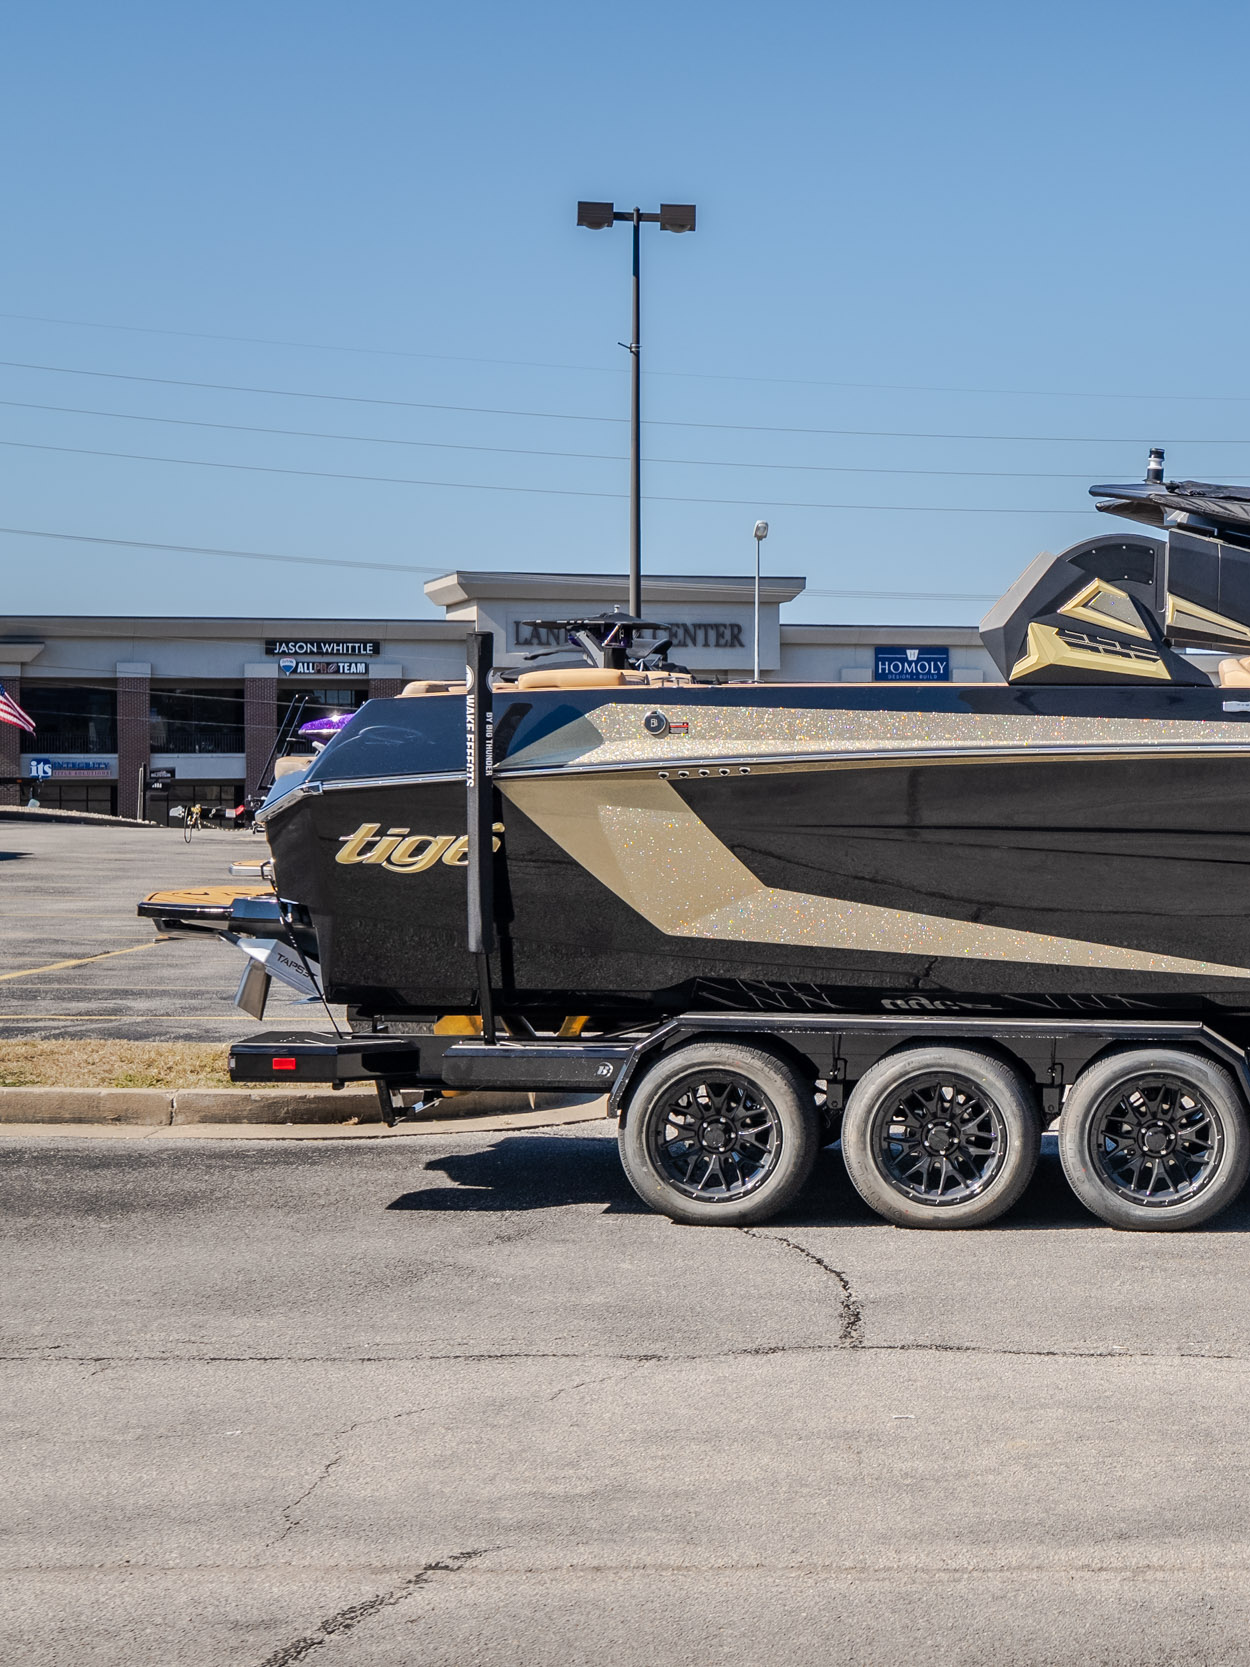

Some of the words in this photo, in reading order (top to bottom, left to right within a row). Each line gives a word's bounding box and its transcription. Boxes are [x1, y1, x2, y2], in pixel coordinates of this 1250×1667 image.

[274, 642, 317, 654] JASON
[320, 643, 374, 654] WHITTLE
[338, 663, 366, 673] TEAM
[878, 661, 947, 674] HOMOLY
[466, 694, 475, 732] WAKE
[485, 711, 493, 723] BY
[485, 724, 493, 738] BIG
[485, 739, 493, 776] THUNDER
[29, 760, 52, 777] its
